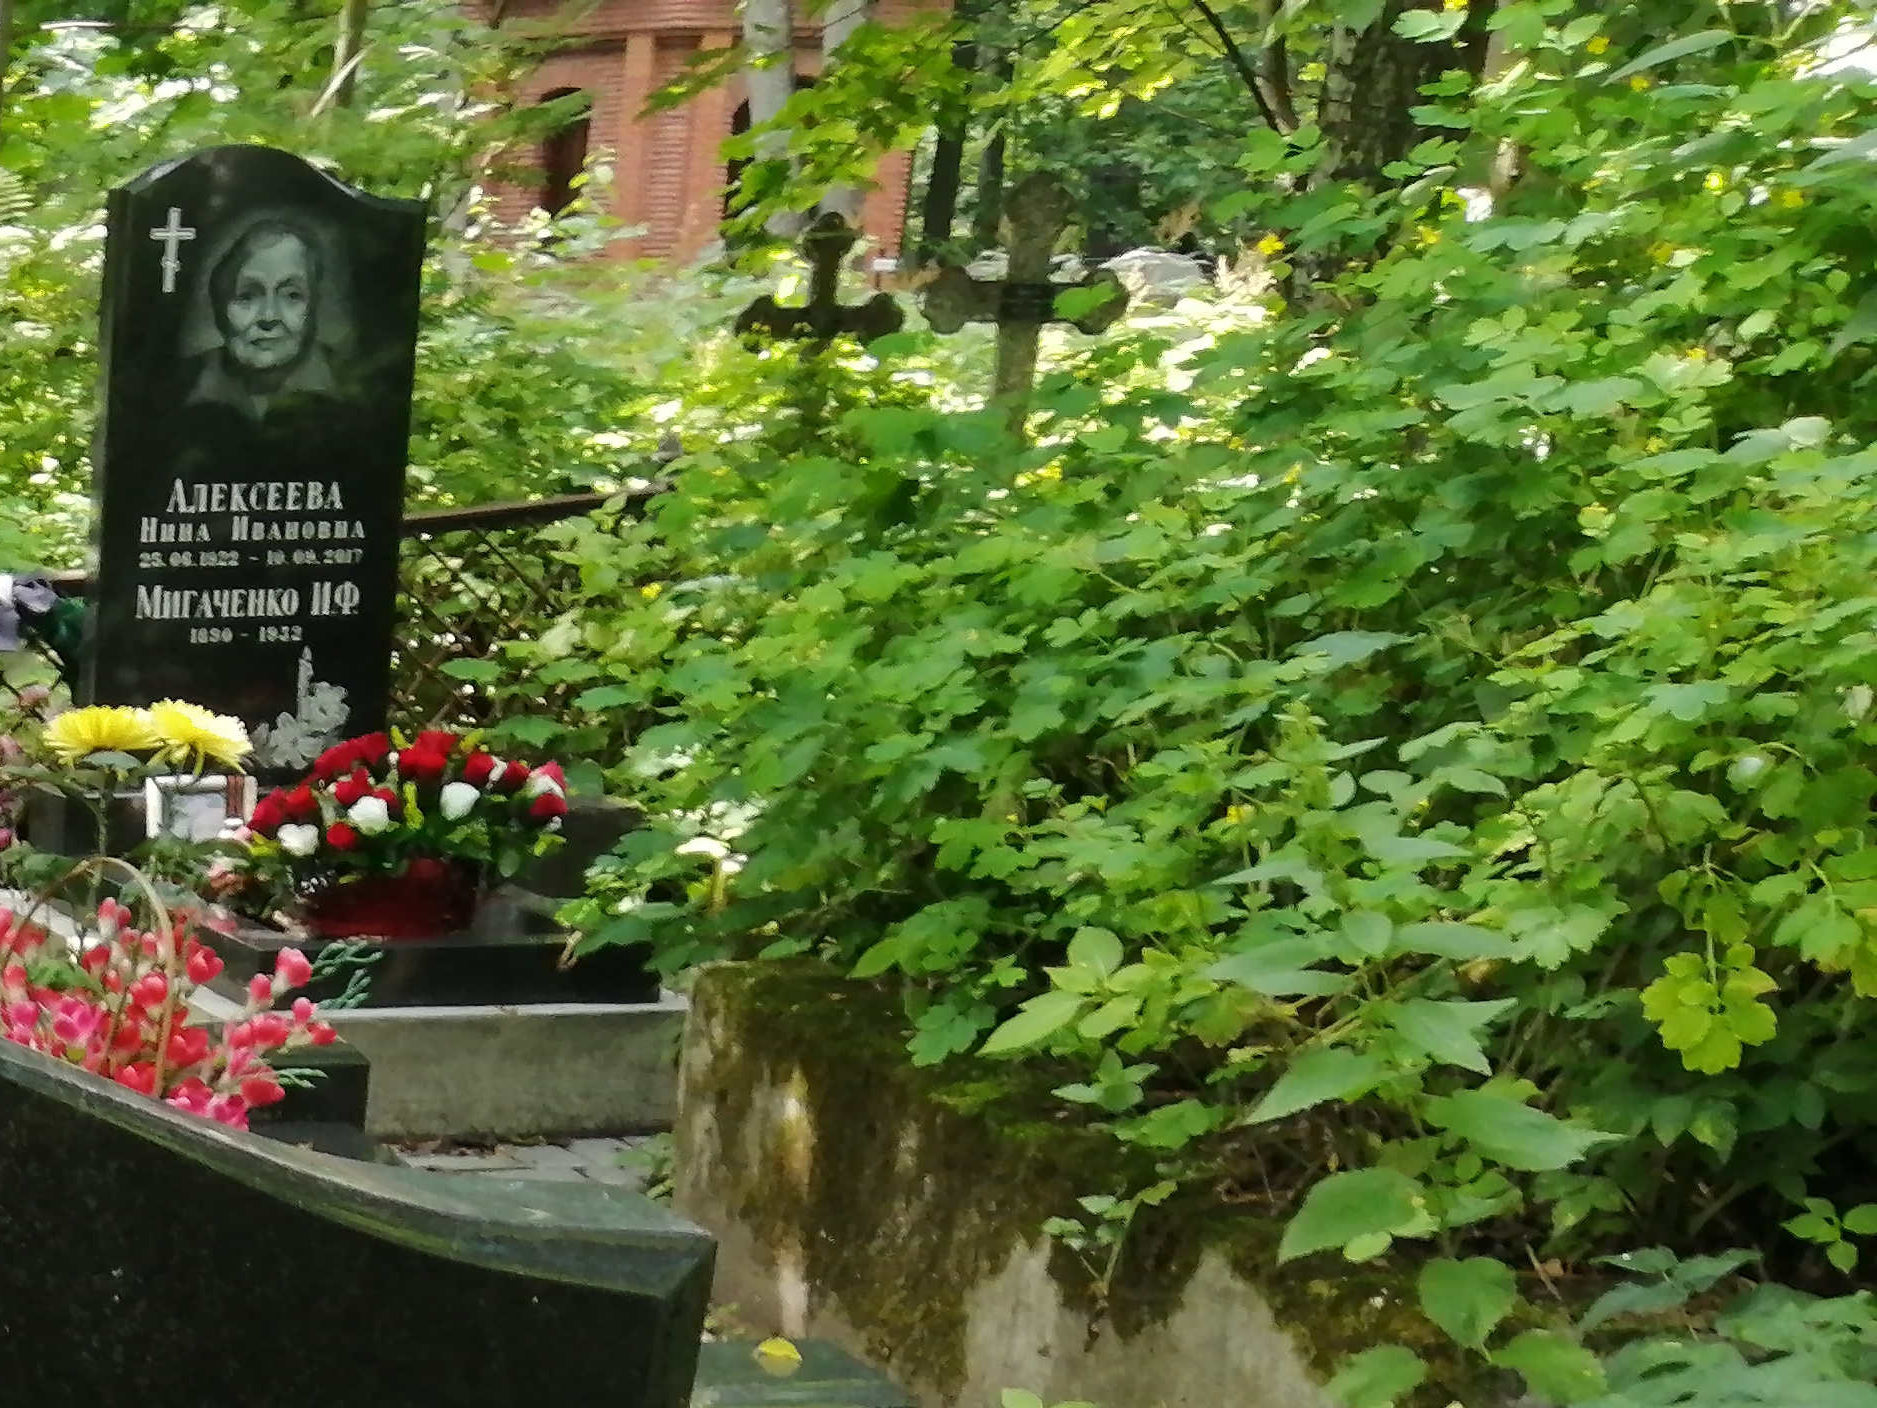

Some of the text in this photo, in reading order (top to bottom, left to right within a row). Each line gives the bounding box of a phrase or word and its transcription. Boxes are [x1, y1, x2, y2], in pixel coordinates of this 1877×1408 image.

[165, 477, 344, 514] АЛЕКСЕЕВА
[139, 514, 366, 544] НИНА ИВАНОВНА
[135, 584, 300, 620] МИГАЧЕНКО
